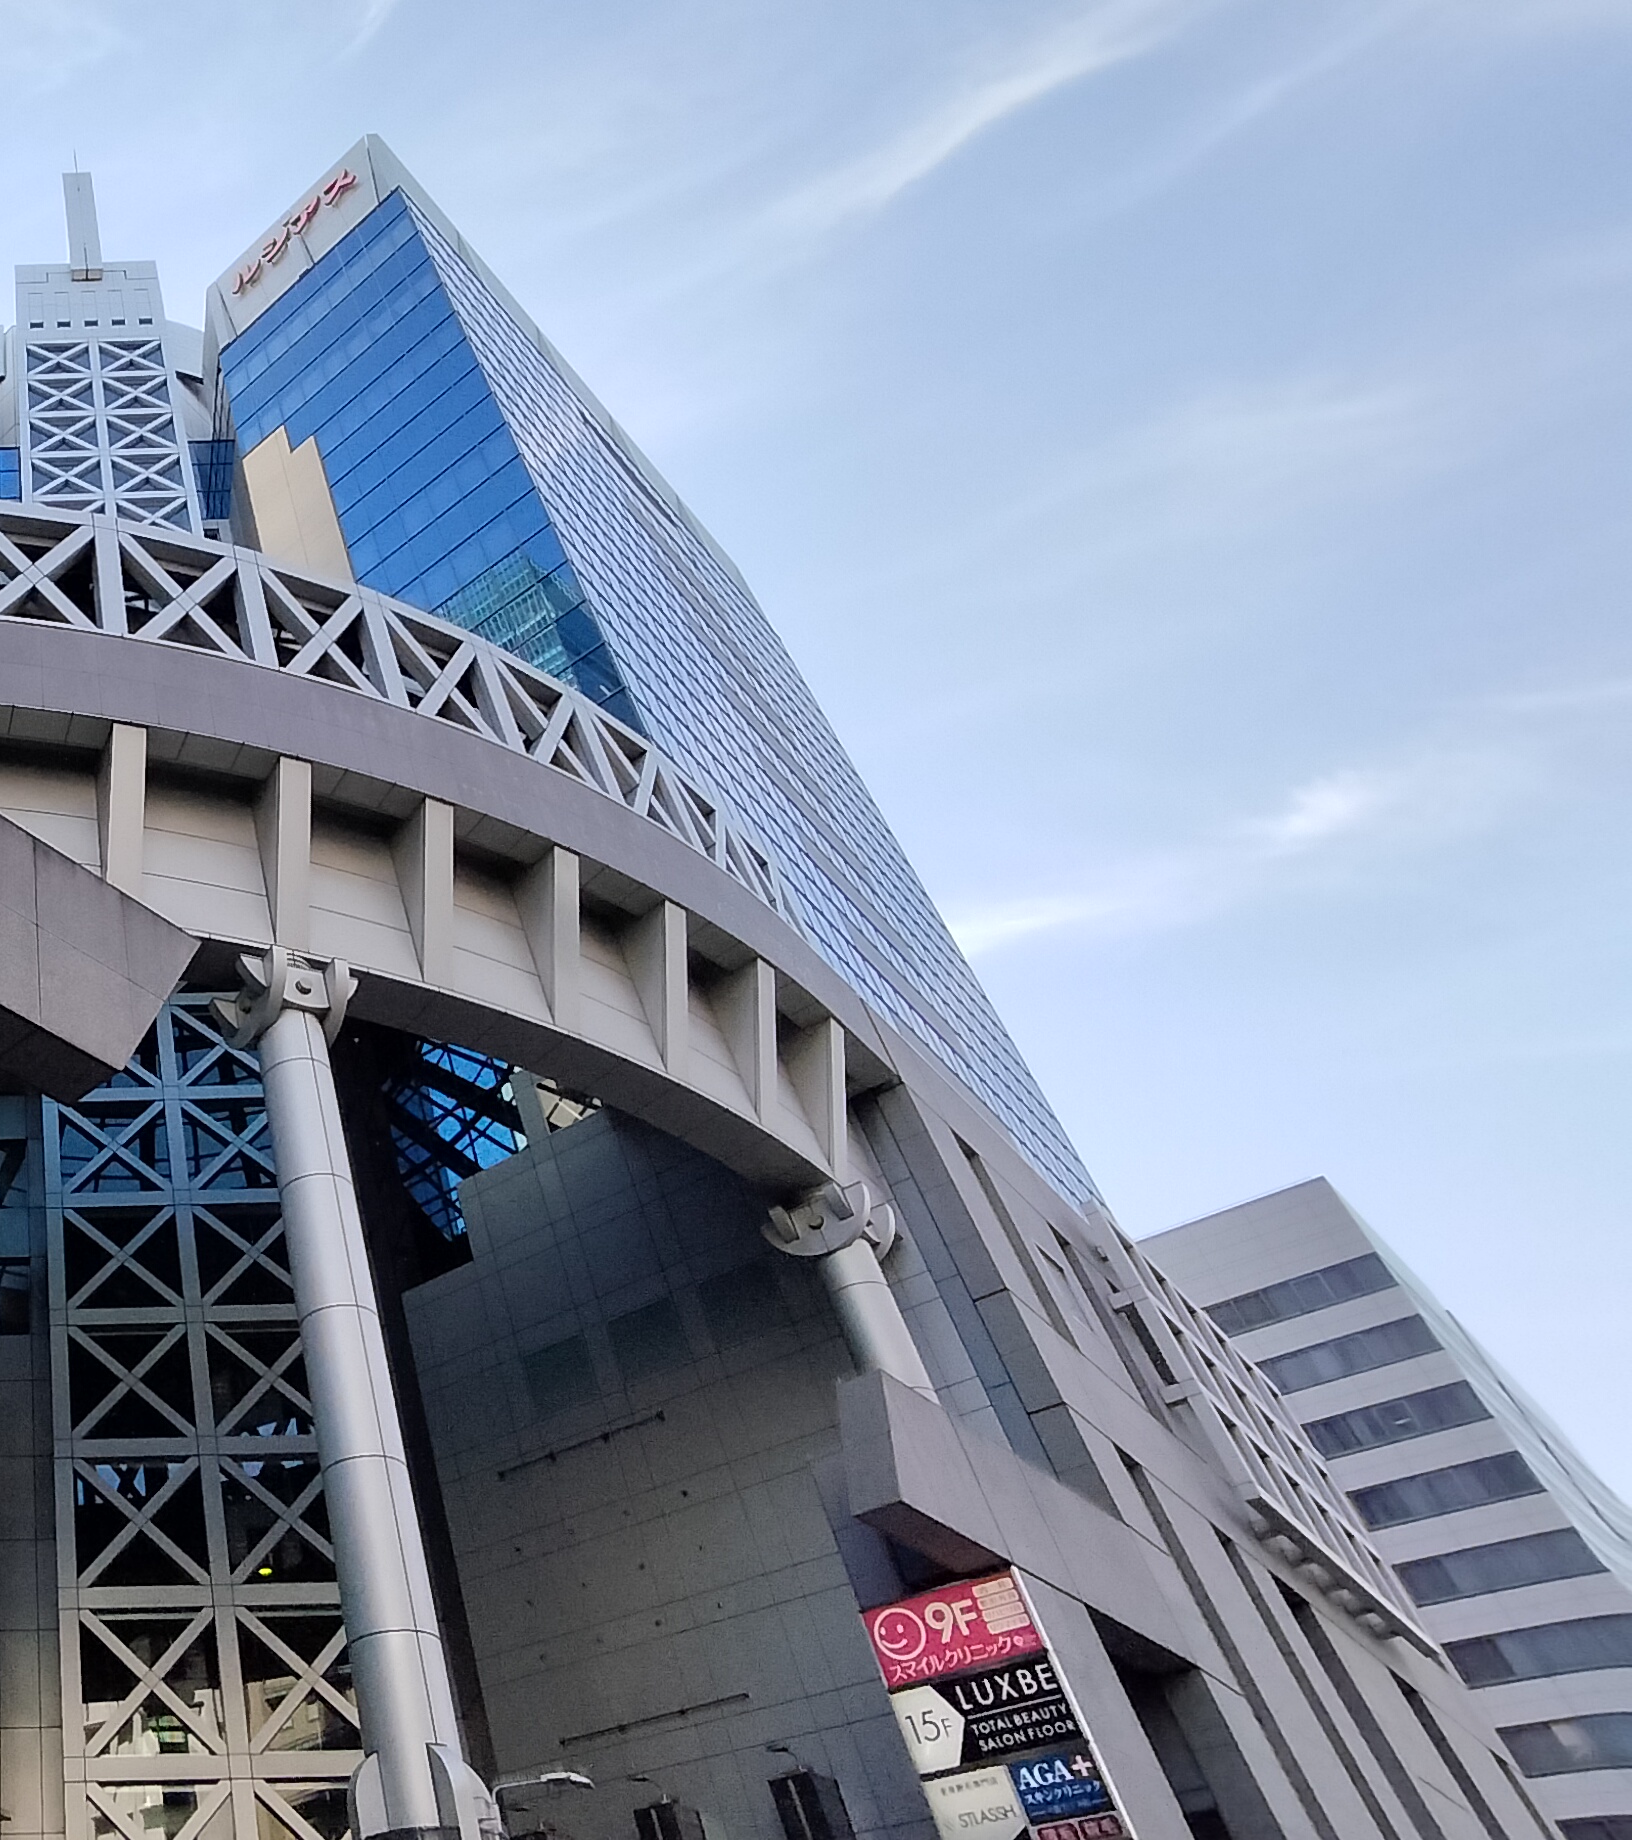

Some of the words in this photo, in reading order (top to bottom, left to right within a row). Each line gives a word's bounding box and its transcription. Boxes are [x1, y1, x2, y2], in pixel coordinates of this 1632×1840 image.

[231, 168, 357, 295] ルシアス
[924, 1598, 978, 1645] 9F
[889, 1636, 1012, 1682] スマイルクリニック
[954, 1664, 1059, 1711] LUXBE
[904, 1709, 955, 1745] 15F
[970, 1718, 1013, 1736] TOTAL
[1014, 1703, 1068, 1727] BEAUTY
[978, 1729, 1027, 1752] SALON
[1027, 1719, 1077, 1741] FLOOR
[1024, 1780, 1102, 1804] スキンクリニック
